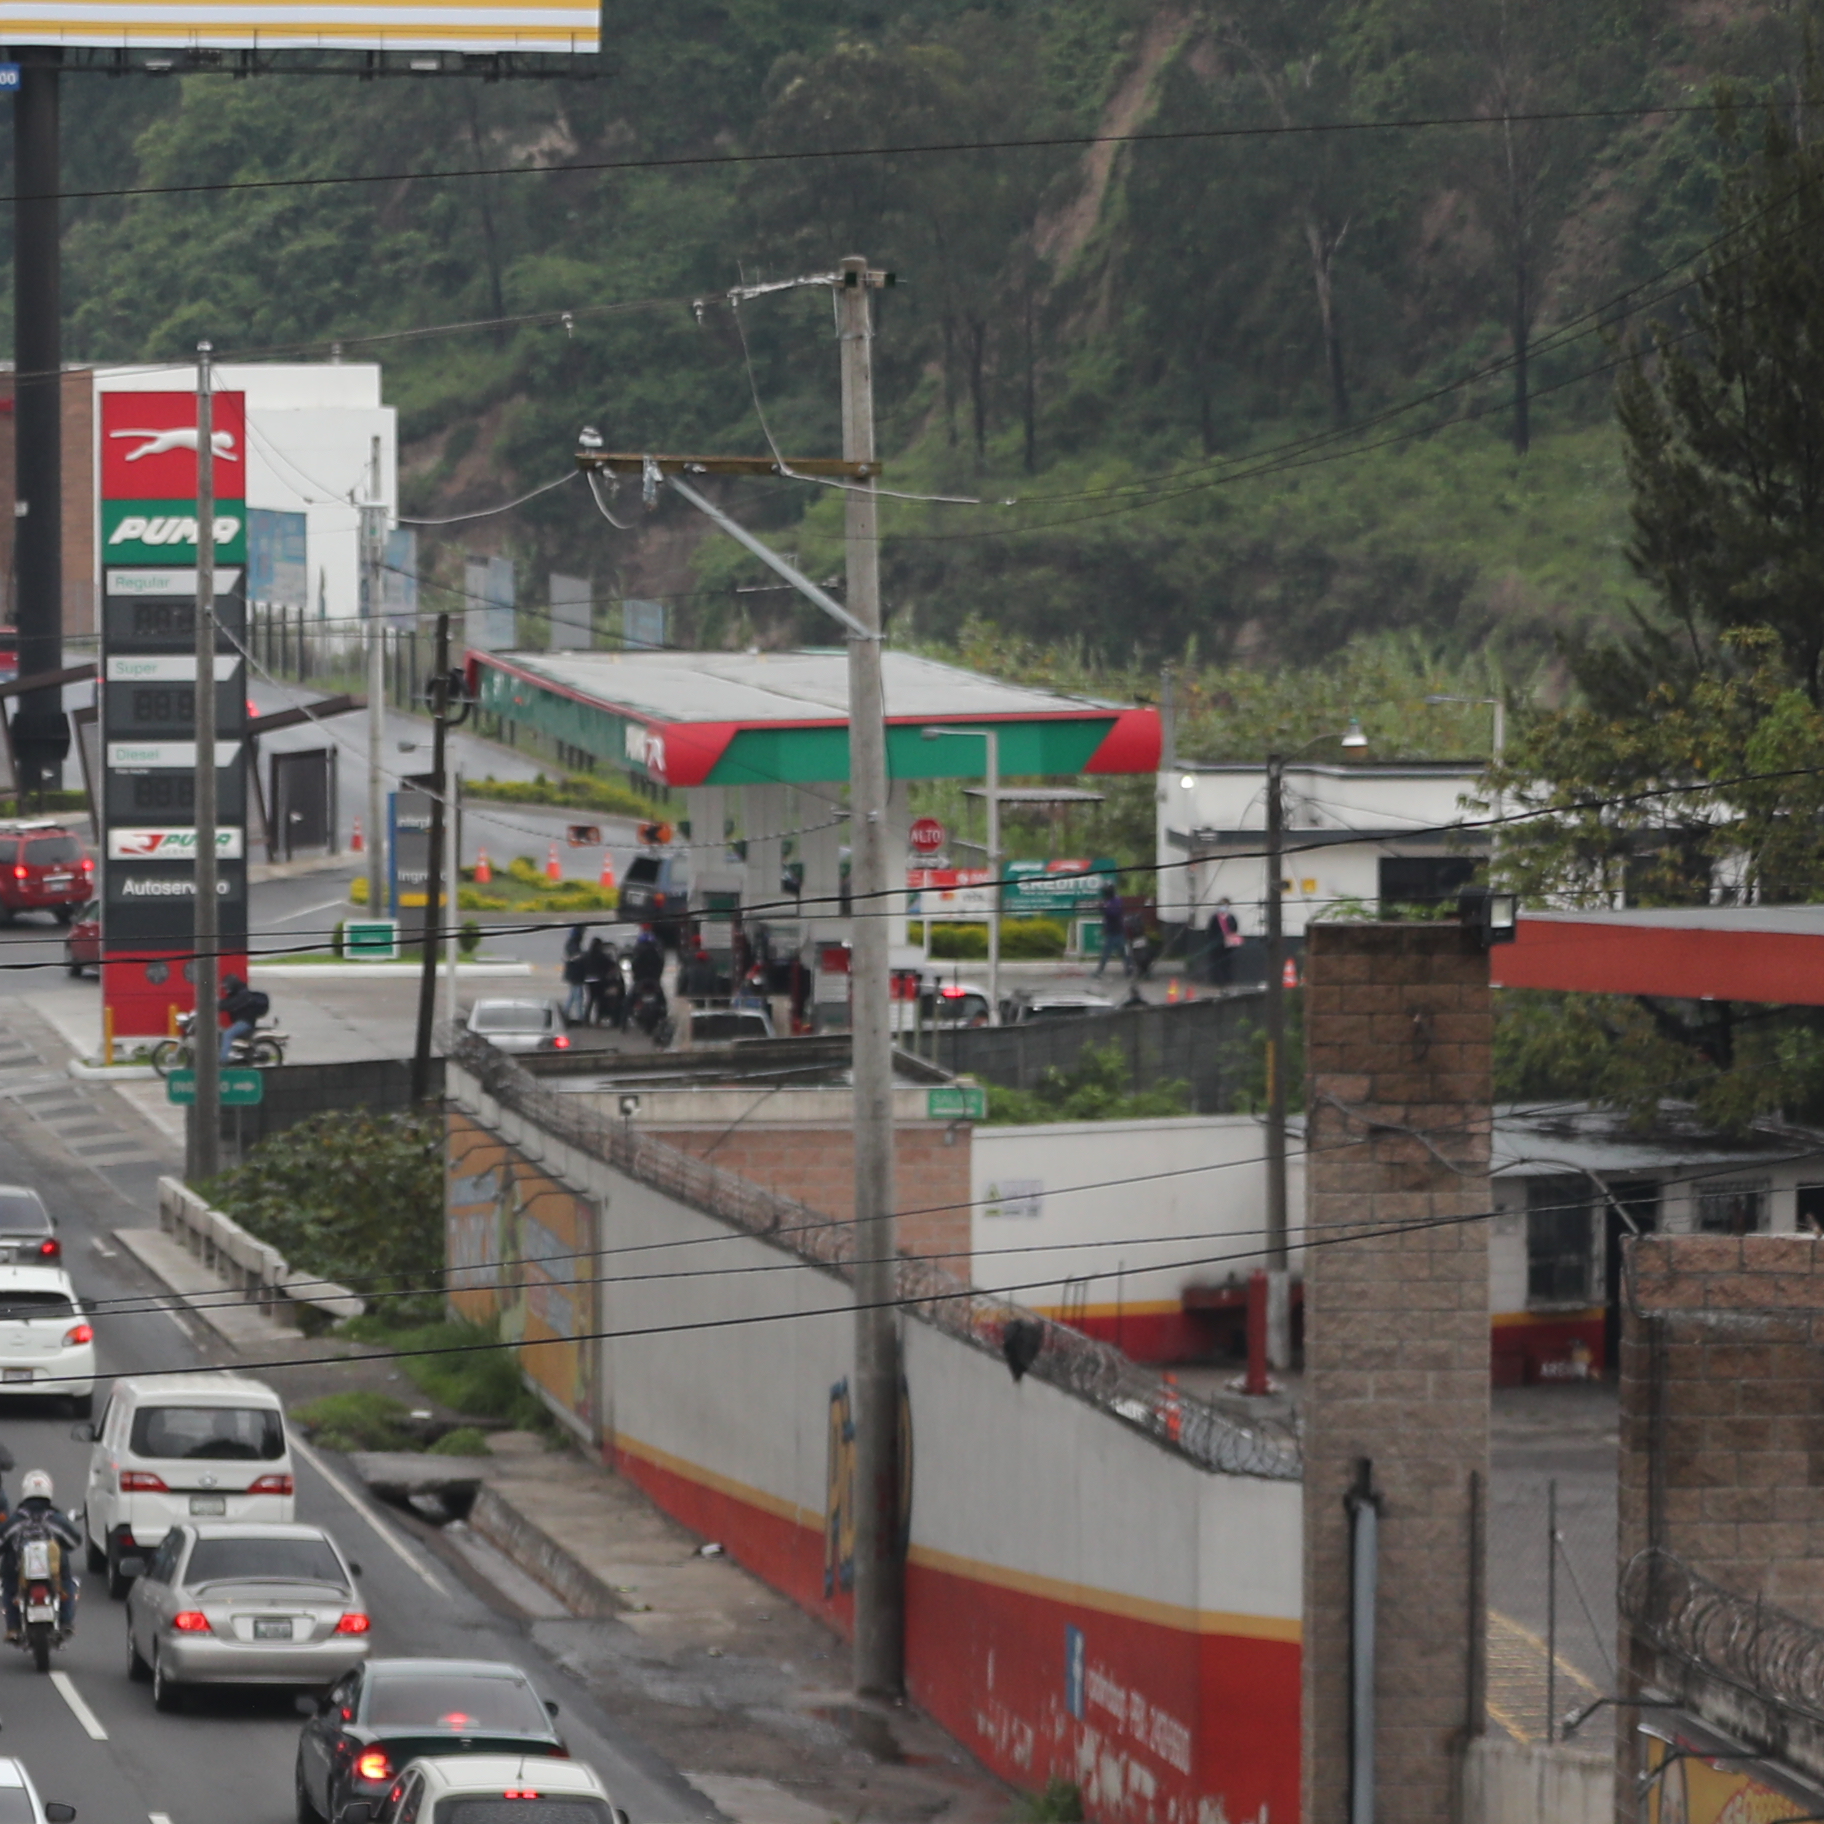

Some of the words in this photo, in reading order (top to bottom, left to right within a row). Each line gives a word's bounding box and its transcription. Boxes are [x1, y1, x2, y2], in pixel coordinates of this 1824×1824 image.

[108, 516, 241, 545] PUMA
[115, 576, 170, 590] Regular
[116, 662, 158, 676] Super
[116, 749, 160, 761] Diesel
[162, 833, 232, 847] PUA
[910, 829, 941, 843] ALTO
